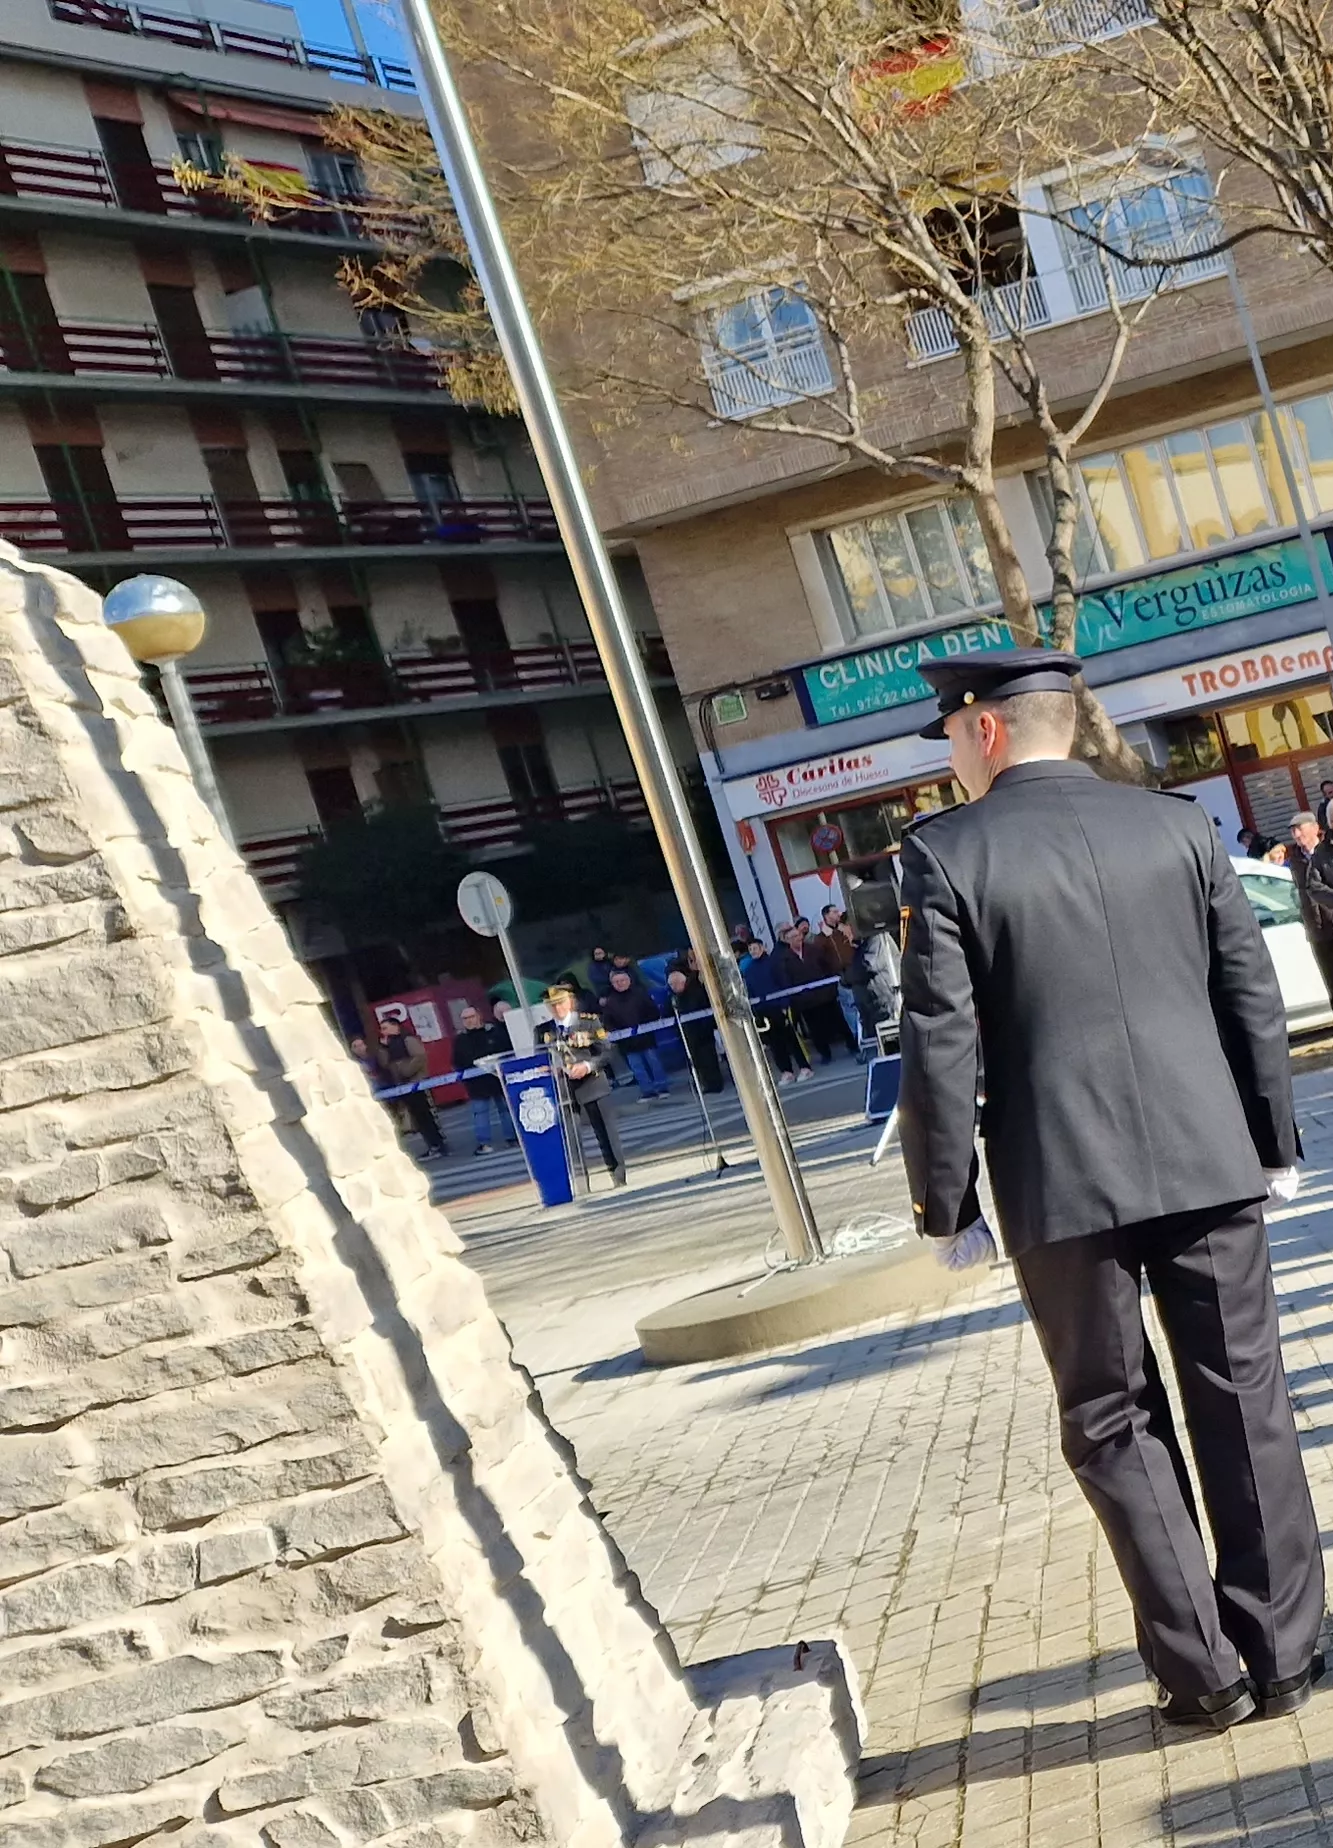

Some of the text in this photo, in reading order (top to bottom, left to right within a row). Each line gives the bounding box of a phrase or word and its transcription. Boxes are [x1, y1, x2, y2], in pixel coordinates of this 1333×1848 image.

[1093, 559, 1287, 629] Verguizas
[942, 609, 1053, 657] DENL
[786, 753, 873, 786] Cáritas
[792, 768, 889, 799] Diocesana de Huesca
